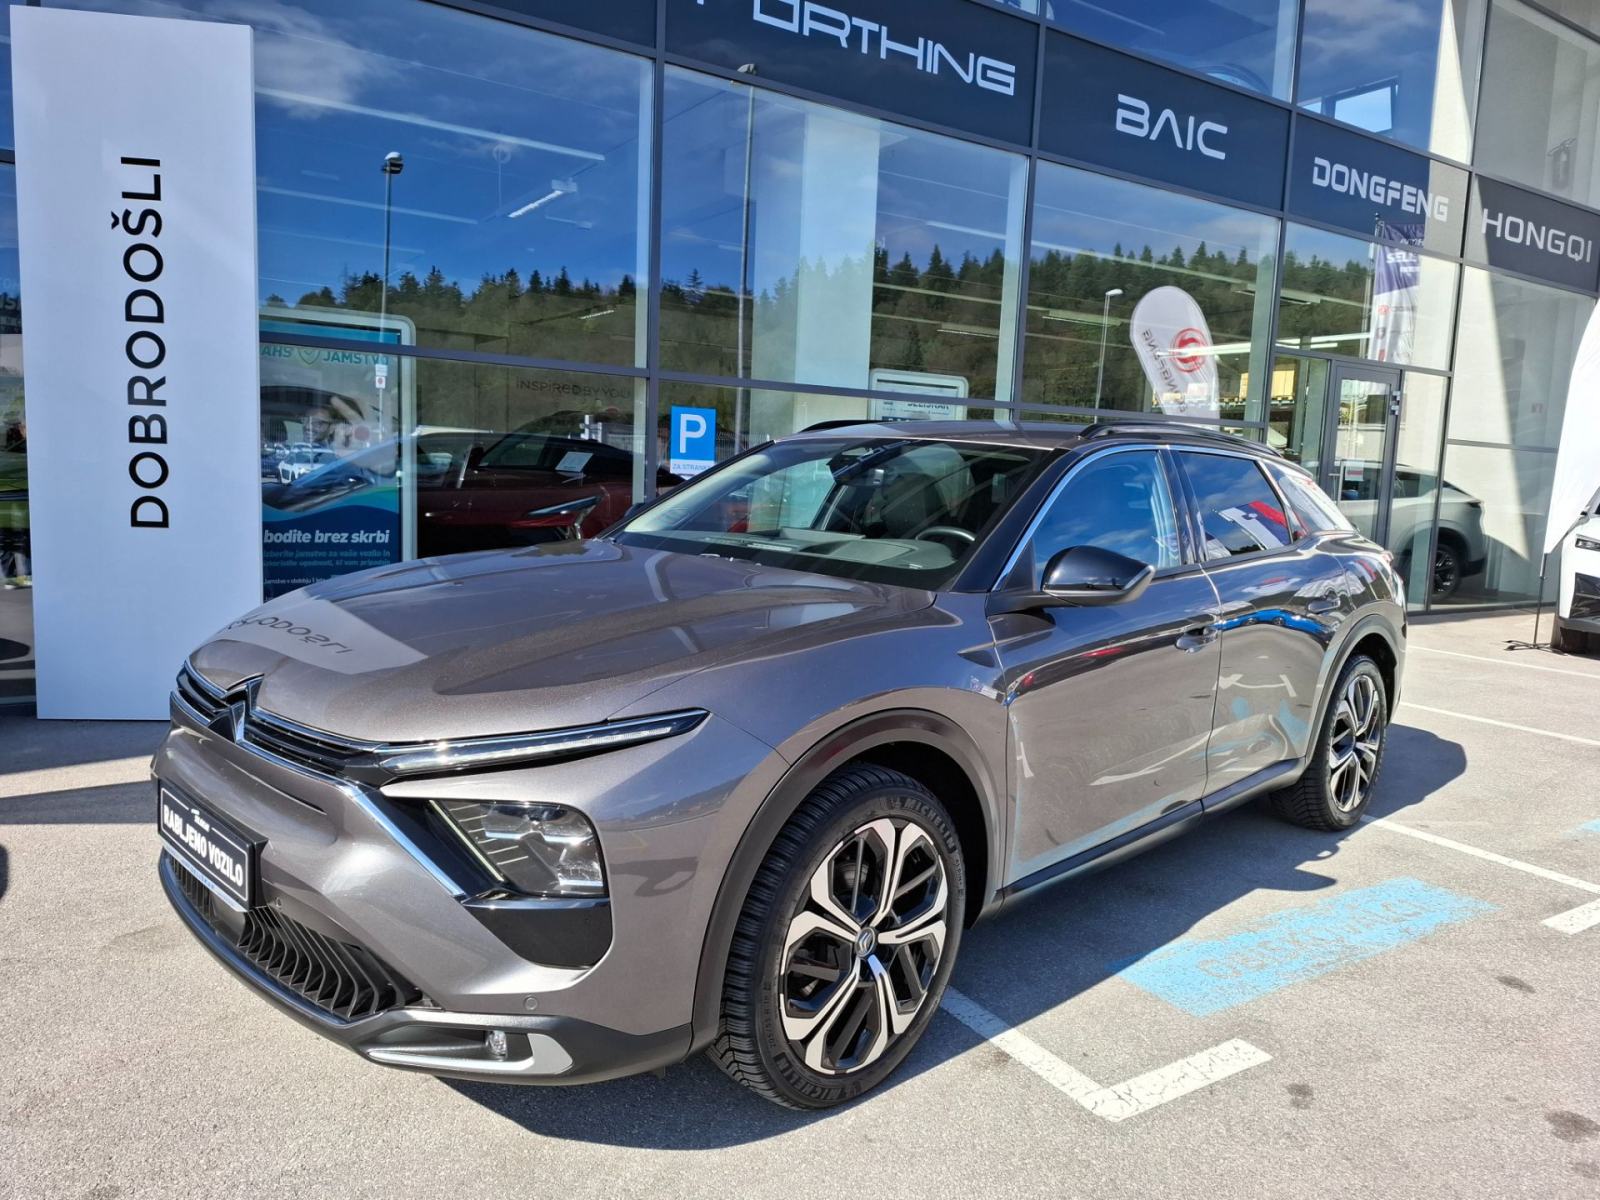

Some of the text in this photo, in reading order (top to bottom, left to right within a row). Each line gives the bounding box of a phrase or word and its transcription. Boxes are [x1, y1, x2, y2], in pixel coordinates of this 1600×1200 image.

[696, 0, 1016, 96] ORTHING
[1116, 93, 1228, 160] BAIC
[1312, 156, 1449, 223] DONGFENG
[1481, 208, 1592, 263] HONGQI
[110, 156, 170, 529] DOBRODOŠLI
[679, 413, 707, 453] P
[264, 529, 390, 543] bodite brez skrbi
[163, 804, 207, 858] RABLJENO
[208, 841, 243, 887] VOZILO
[904, 798, 957, 853] MICHELIN
